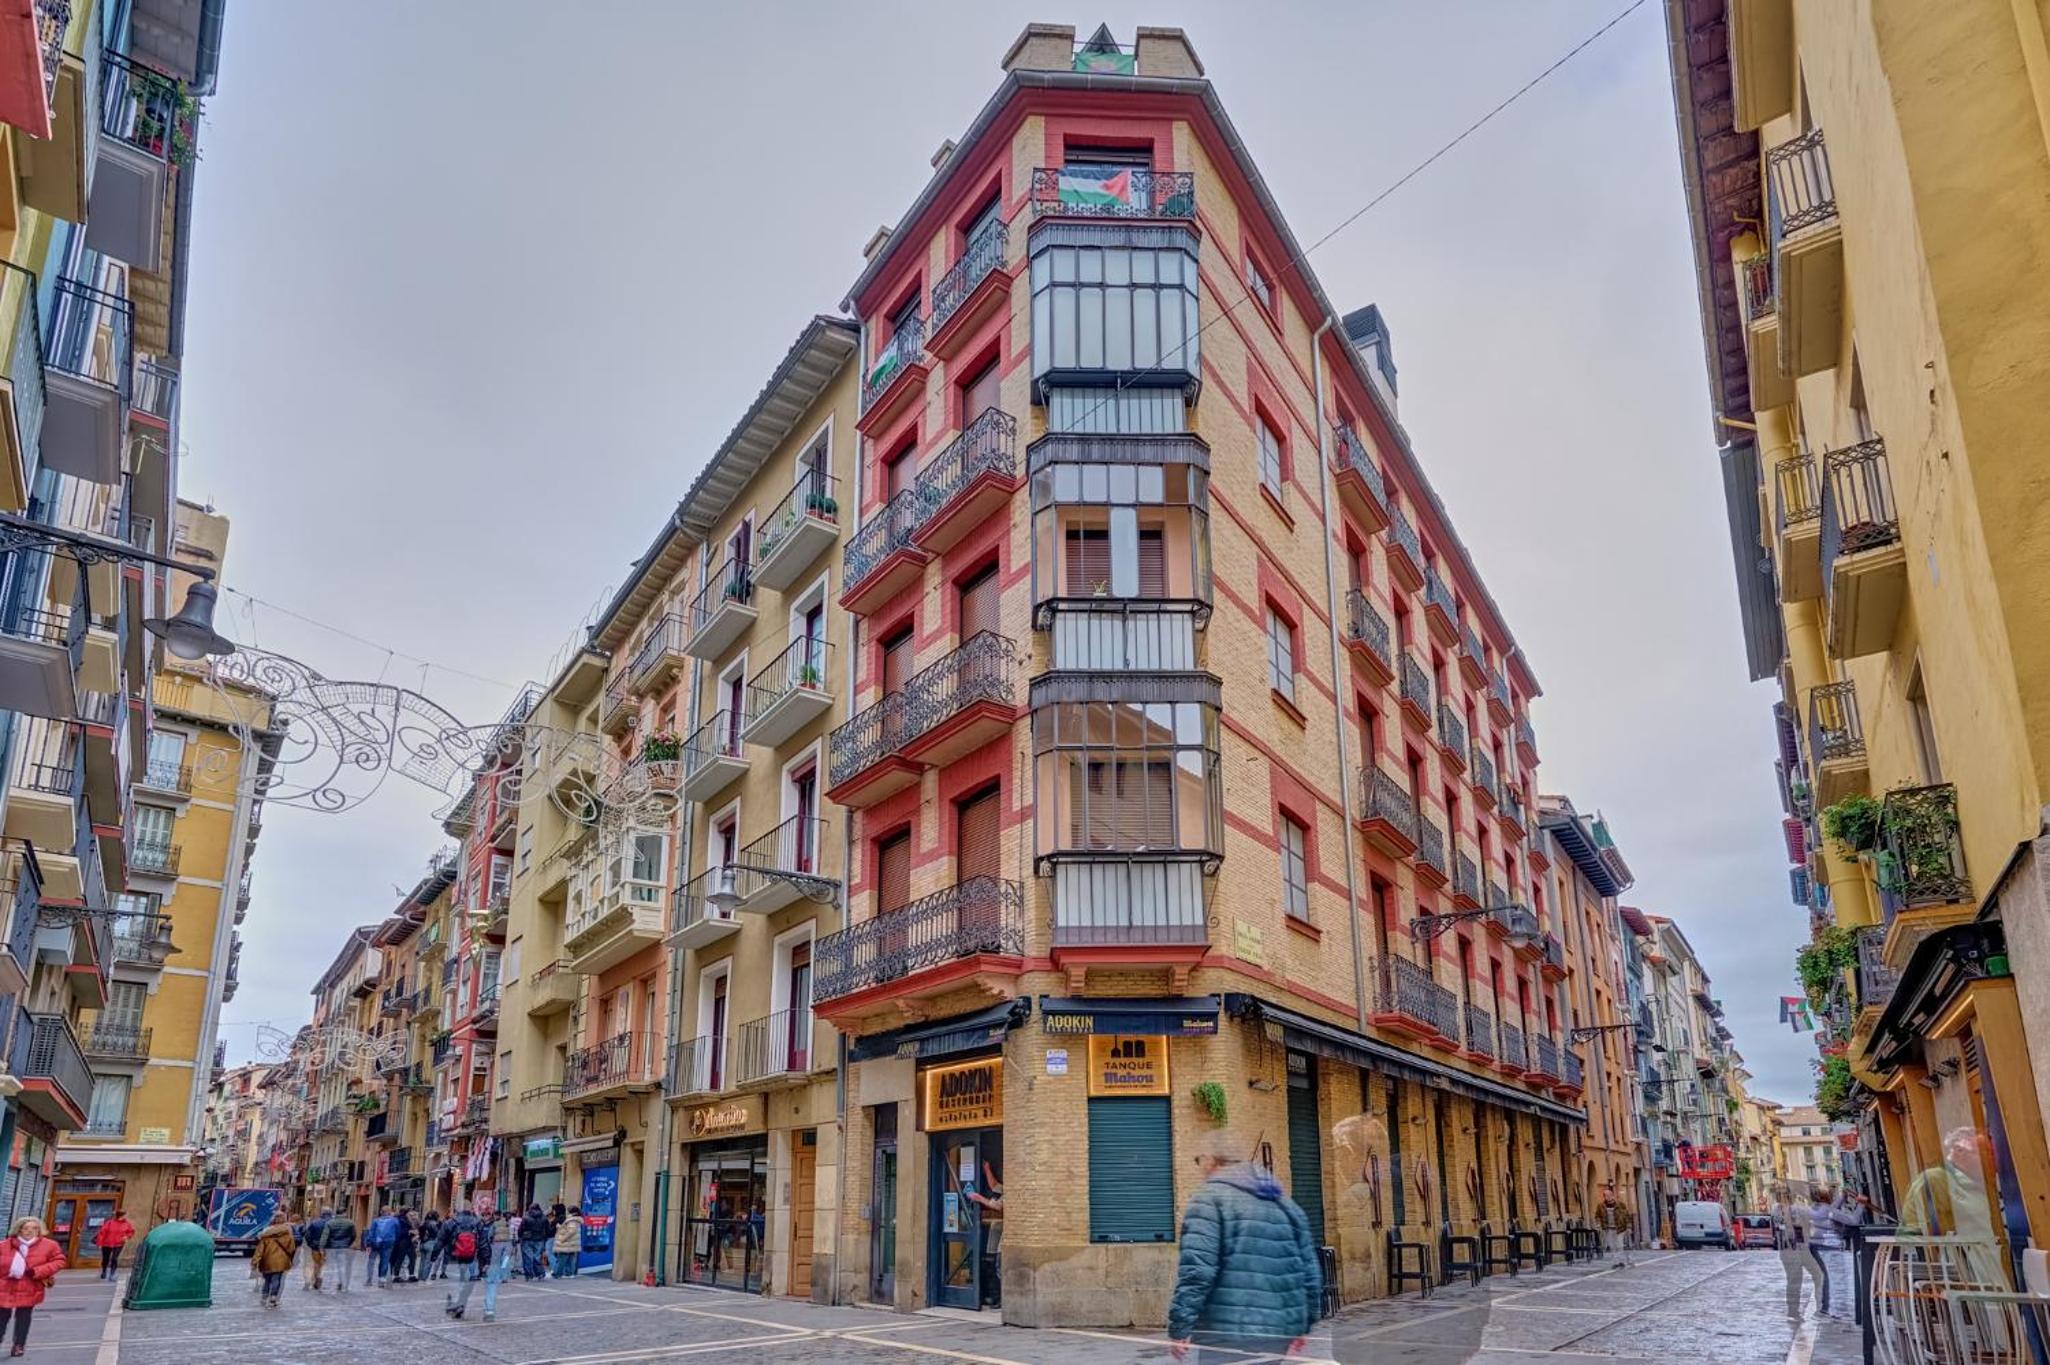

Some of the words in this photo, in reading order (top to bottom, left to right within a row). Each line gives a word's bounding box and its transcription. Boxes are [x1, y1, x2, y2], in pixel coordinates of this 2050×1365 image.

[1046, 1014, 1094, 1028] ADOKIN
[1104, 1061, 1153, 1070] TANQUE
[939, 1065, 993, 1098] ADOKIN
[1104, 1072, 1154, 1083] Mahou
